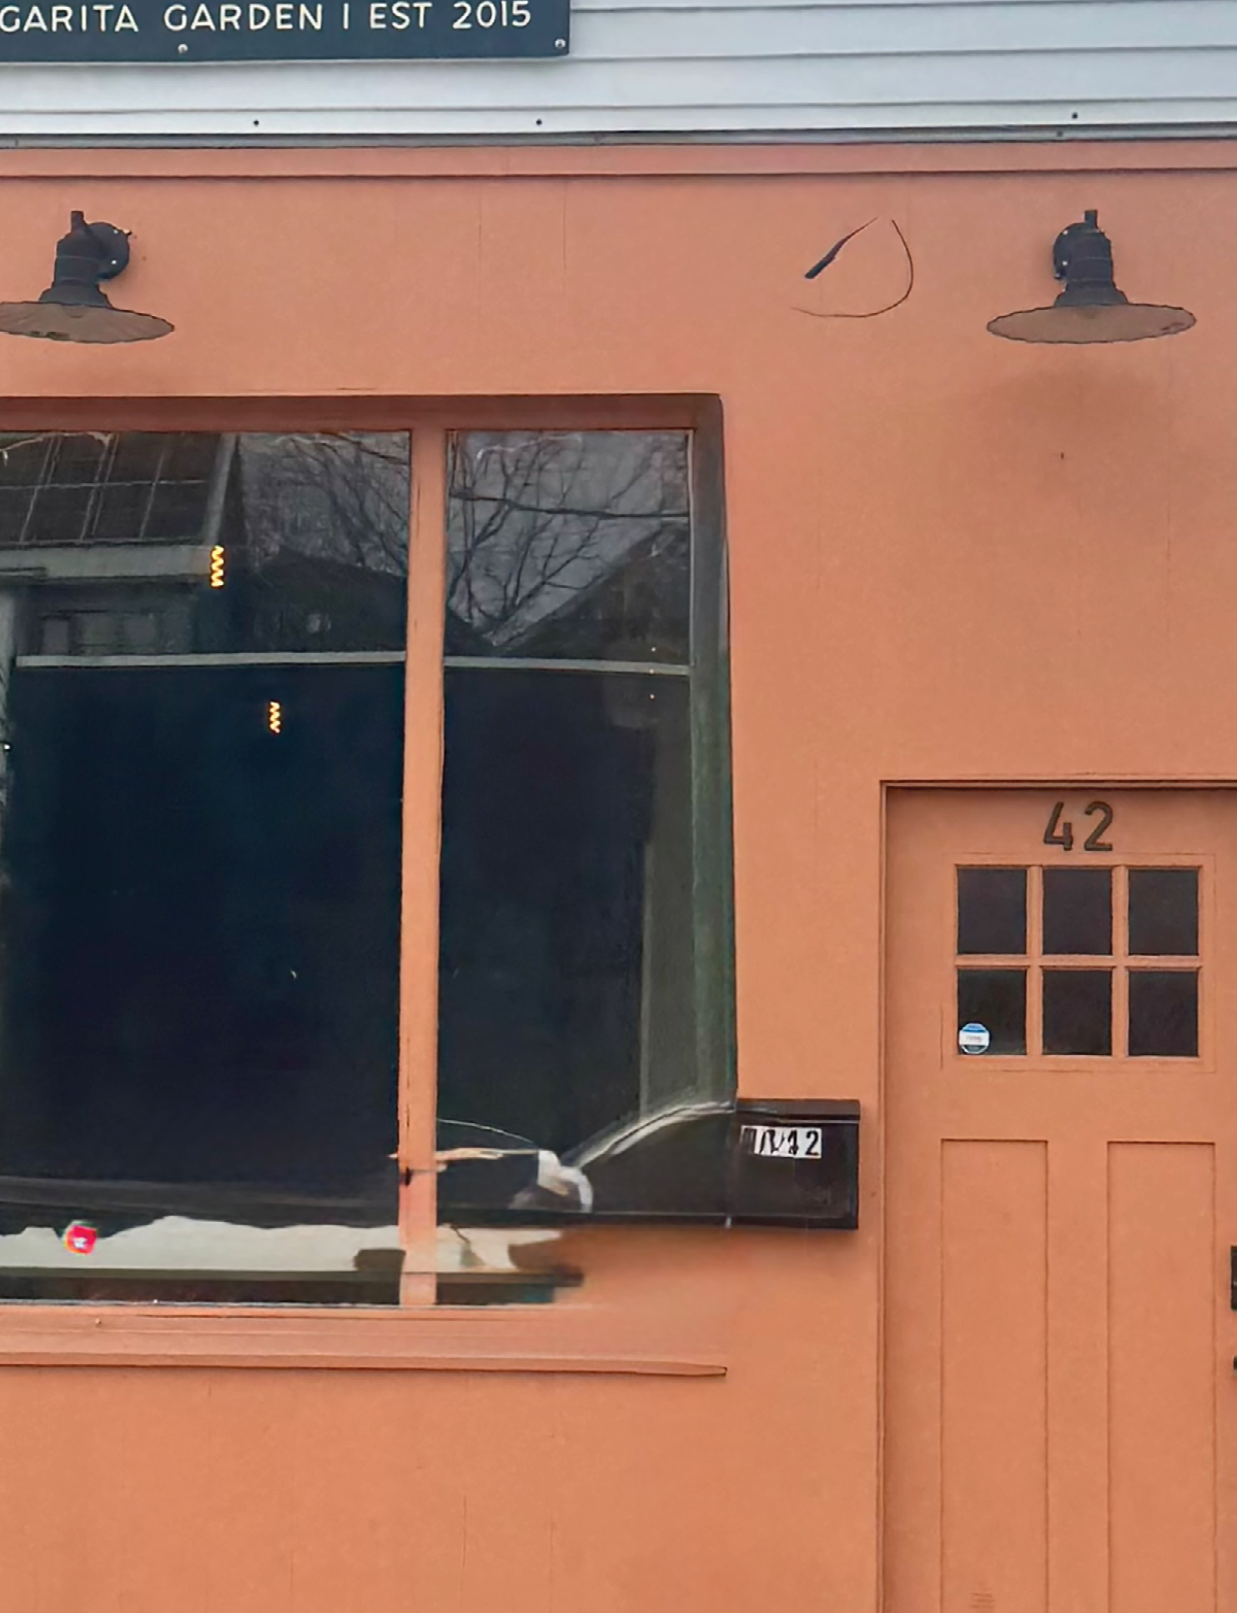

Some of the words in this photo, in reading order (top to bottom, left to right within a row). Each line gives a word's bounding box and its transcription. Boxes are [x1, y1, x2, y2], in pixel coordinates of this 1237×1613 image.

[164, 3, 323, 31] GARDEN
[369, 1, 433, 30] EST
[452, 0, 531, 29] 2015
[1043, 800, 1113, 851] 42
